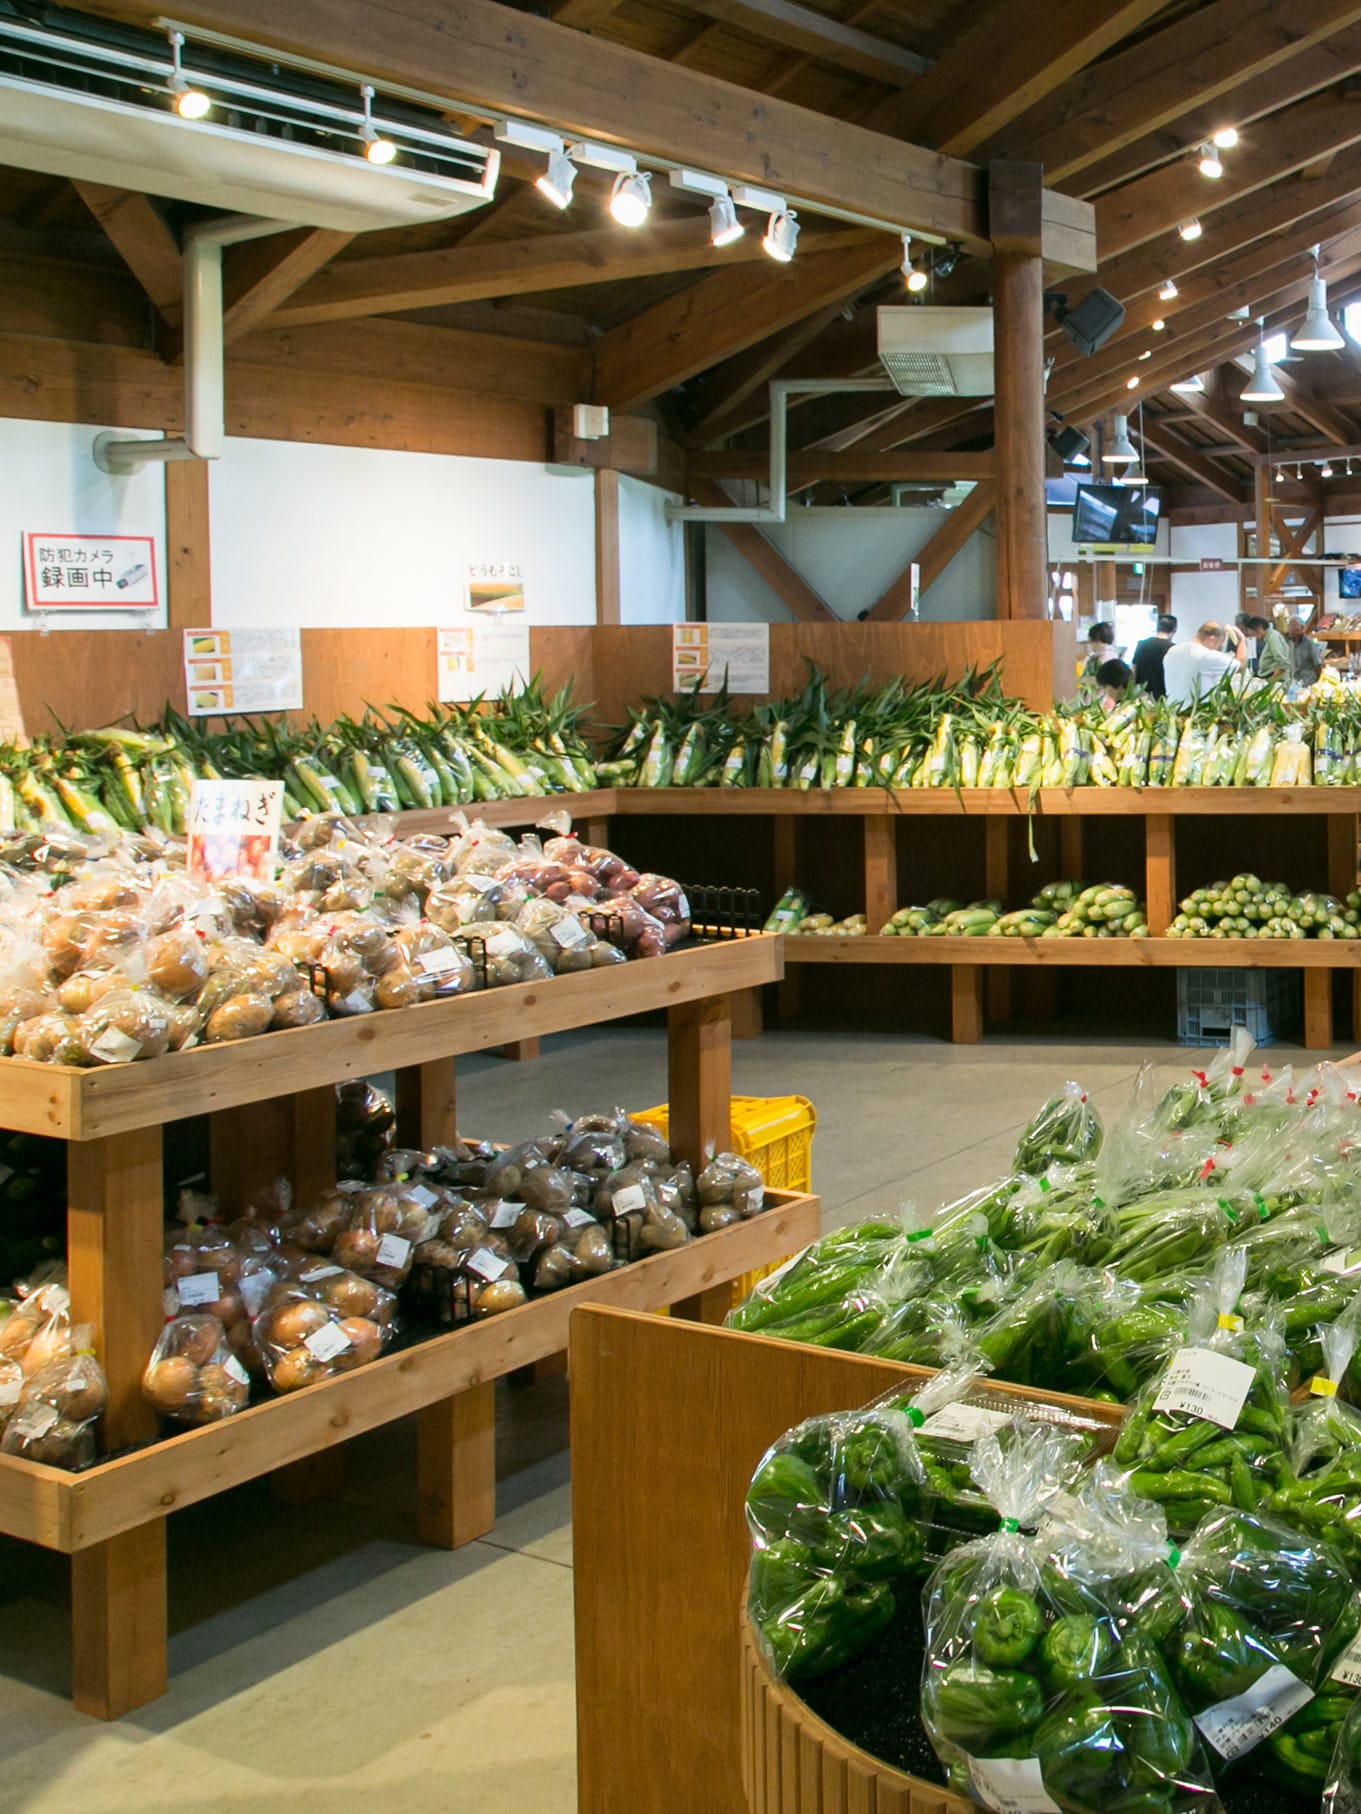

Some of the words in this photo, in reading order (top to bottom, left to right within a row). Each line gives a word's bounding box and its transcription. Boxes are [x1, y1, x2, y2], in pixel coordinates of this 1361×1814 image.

[39, 547, 113, 564] 防犯カメラ
[41, 566, 113, 588] 録画中
[1179, 1401, 1204, 1415] ¥130
